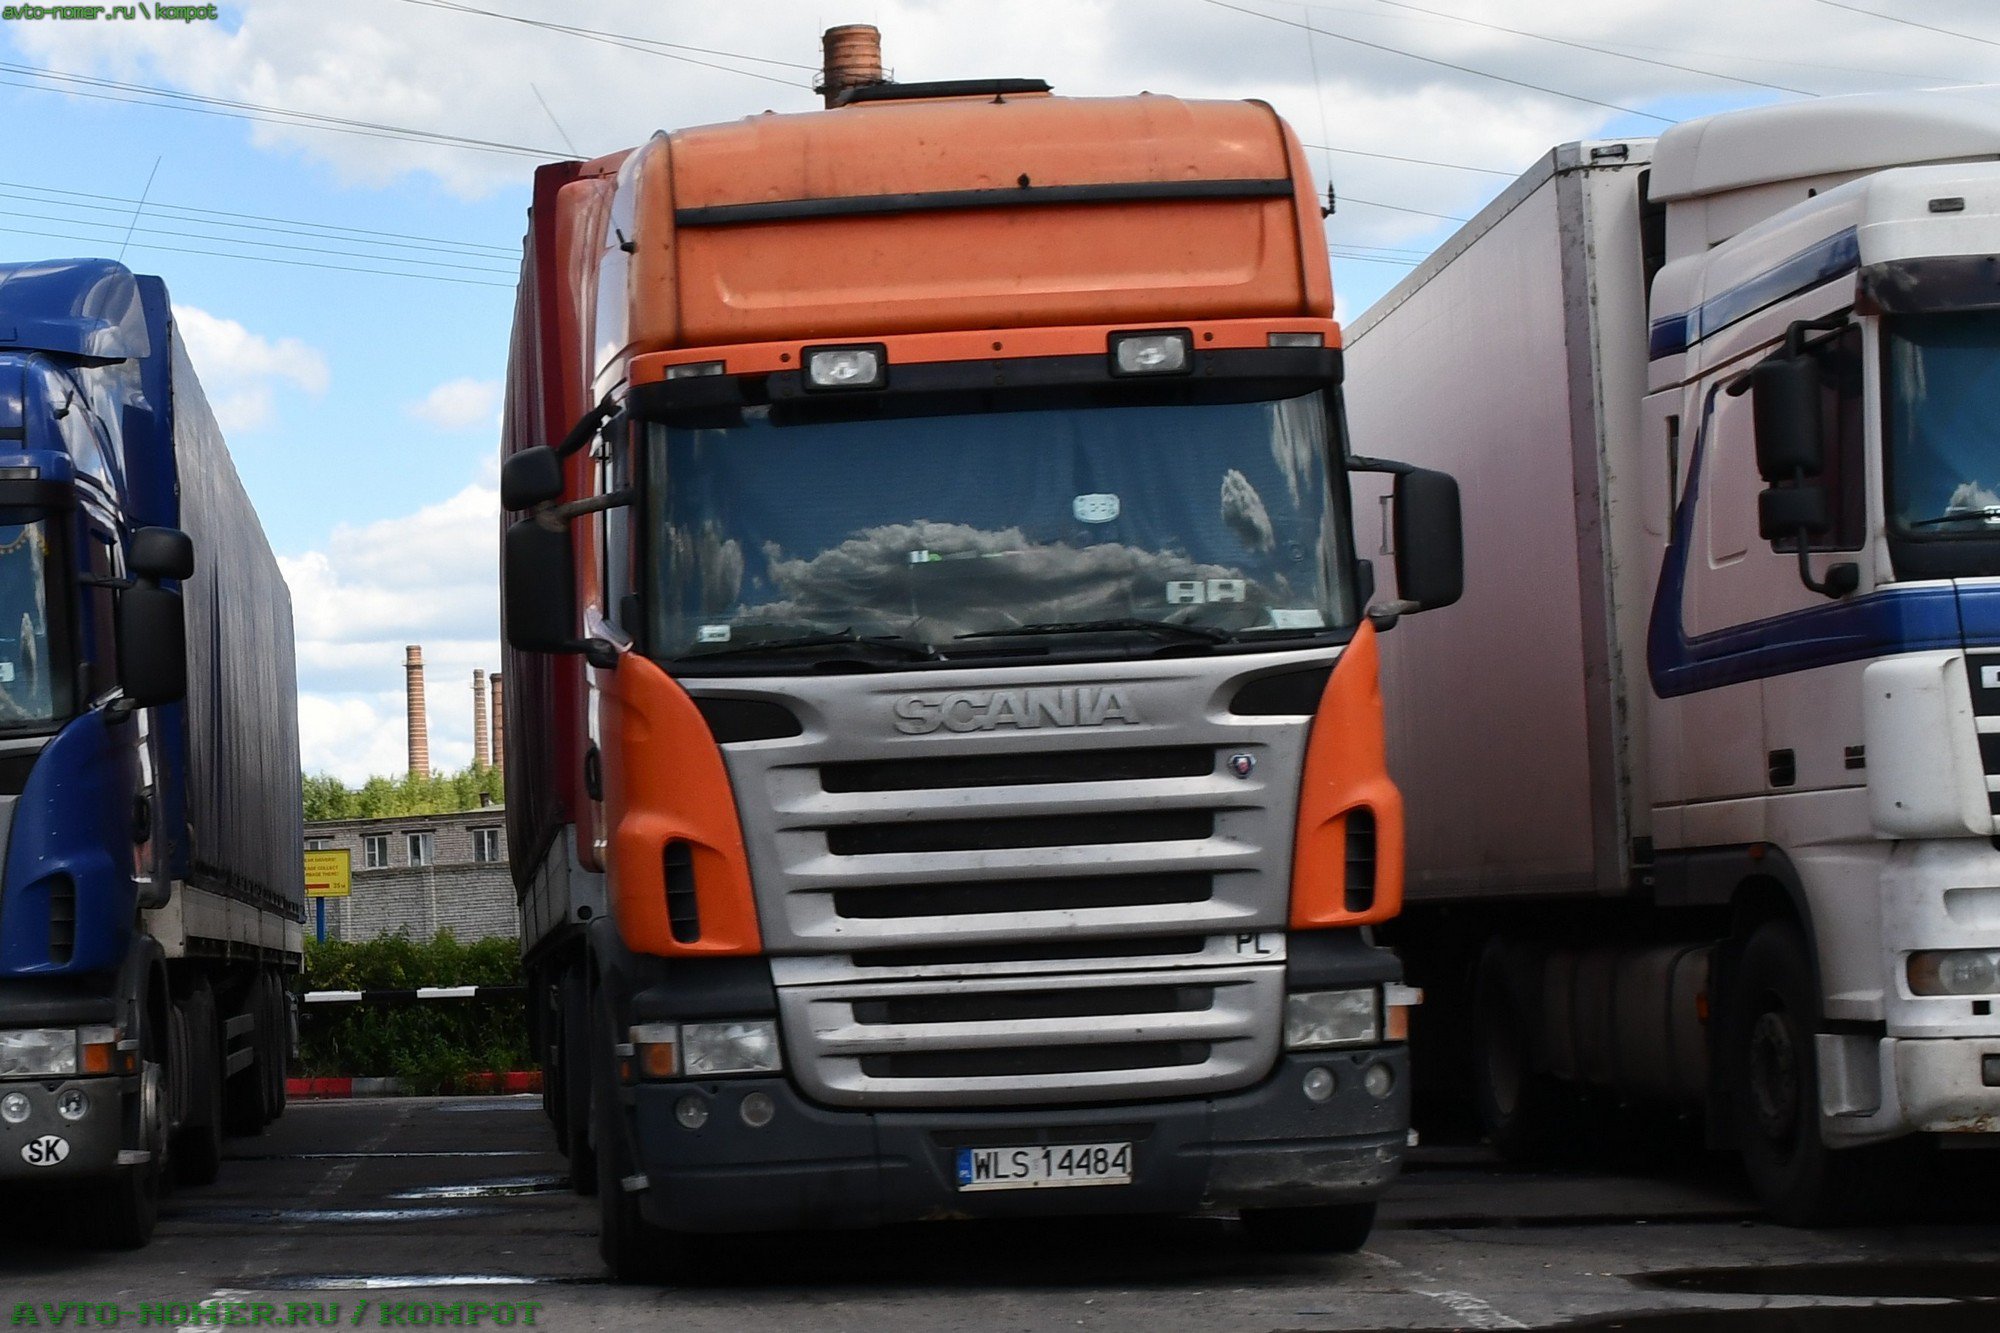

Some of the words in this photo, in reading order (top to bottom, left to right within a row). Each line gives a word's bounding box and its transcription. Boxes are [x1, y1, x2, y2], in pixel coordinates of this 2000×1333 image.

[893, 687, 1140, 735] SCANIA
[1237, 933, 1270, 954] PL
[29, 1139, 61, 1162] SK
[974, 1151, 1030, 1180] WLS
[1041, 1147, 1127, 1177] 14484
